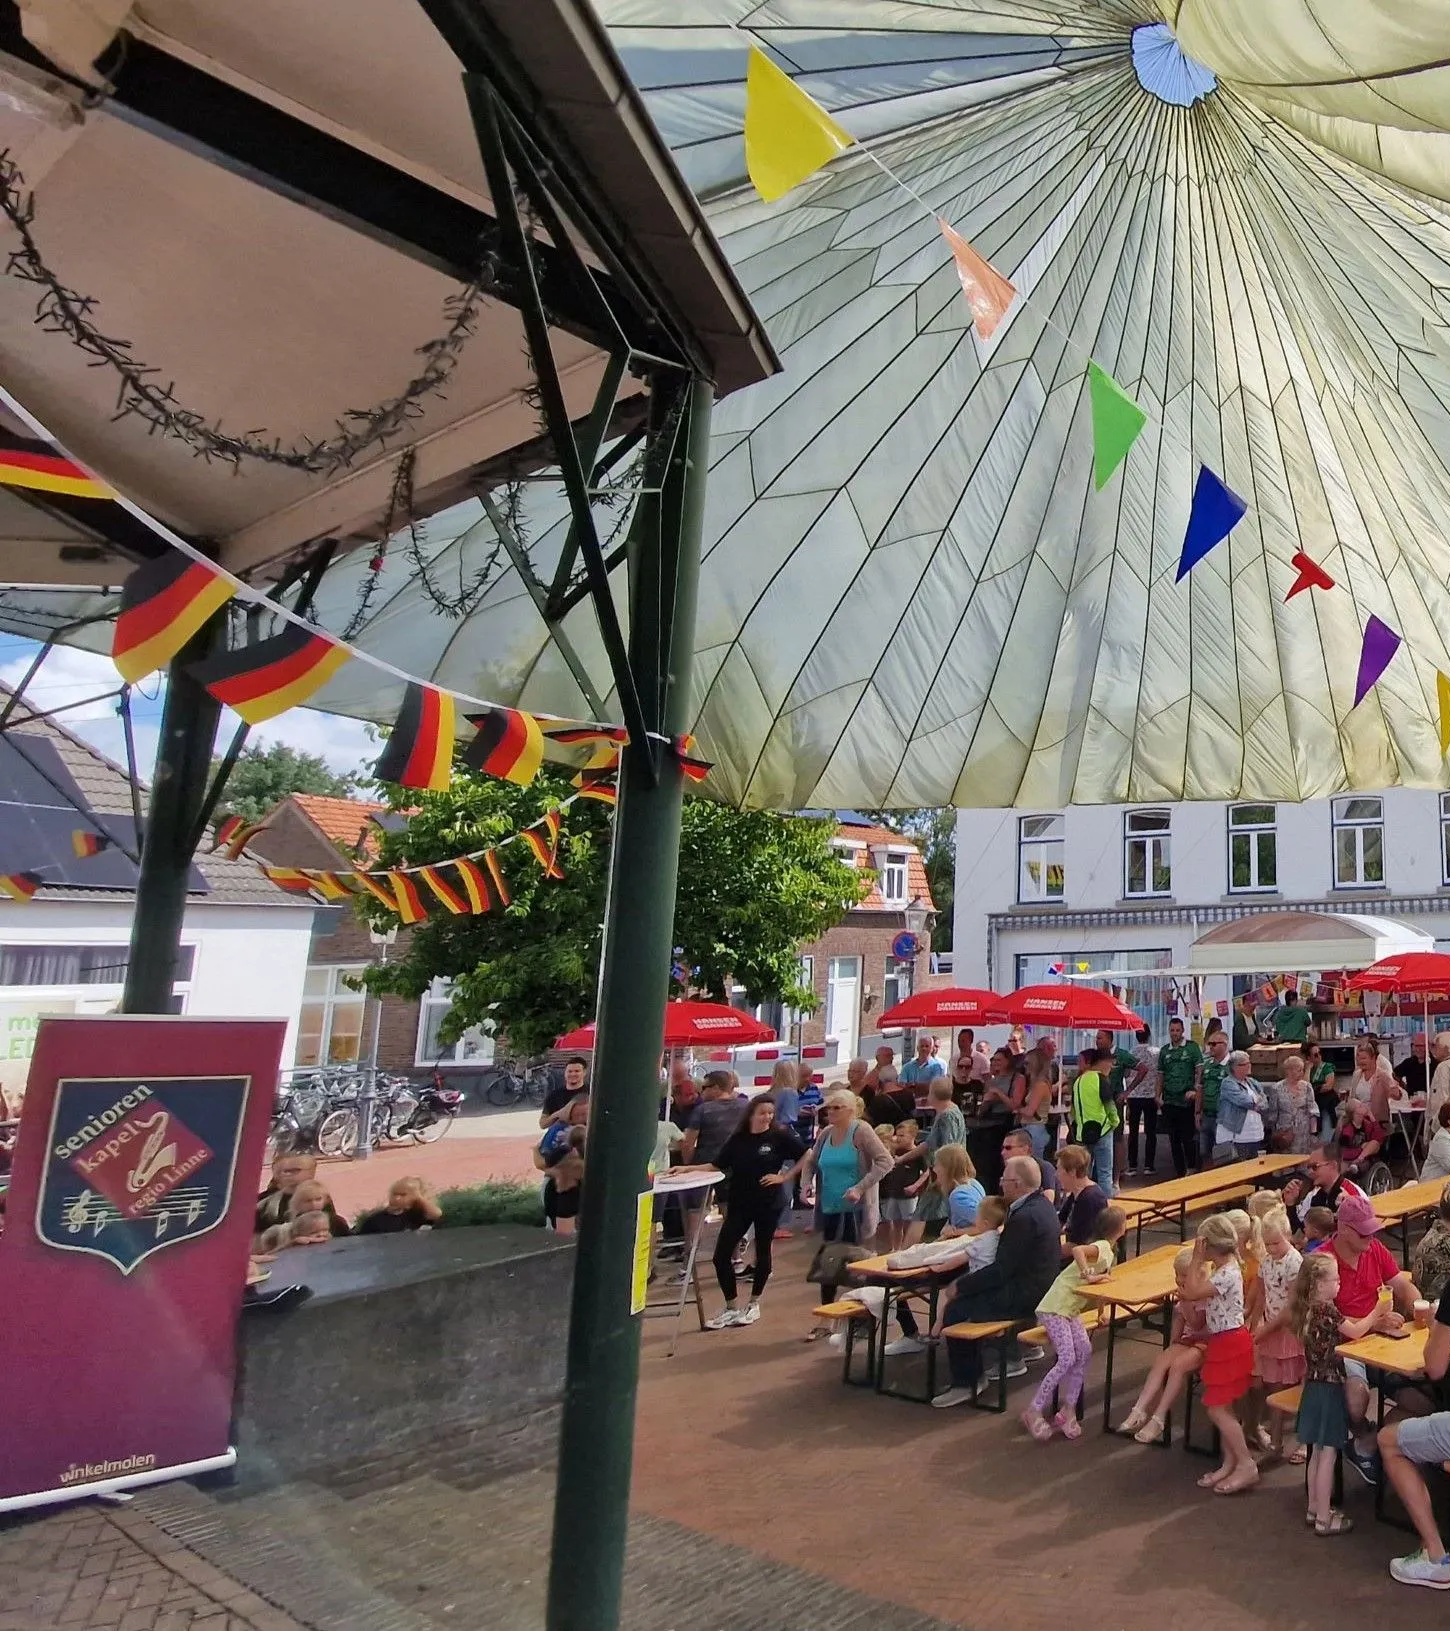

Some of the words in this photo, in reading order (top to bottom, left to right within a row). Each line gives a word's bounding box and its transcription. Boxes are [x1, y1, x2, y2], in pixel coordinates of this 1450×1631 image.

[55, 1084, 154, 1160] senioren
[77, 1121, 142, 1174] kapel
[129, 1181, 166, 1214] regio
[163, 1148, 208, 1183] Linne
[60, 1453, 155, 1483] winkelmolen
